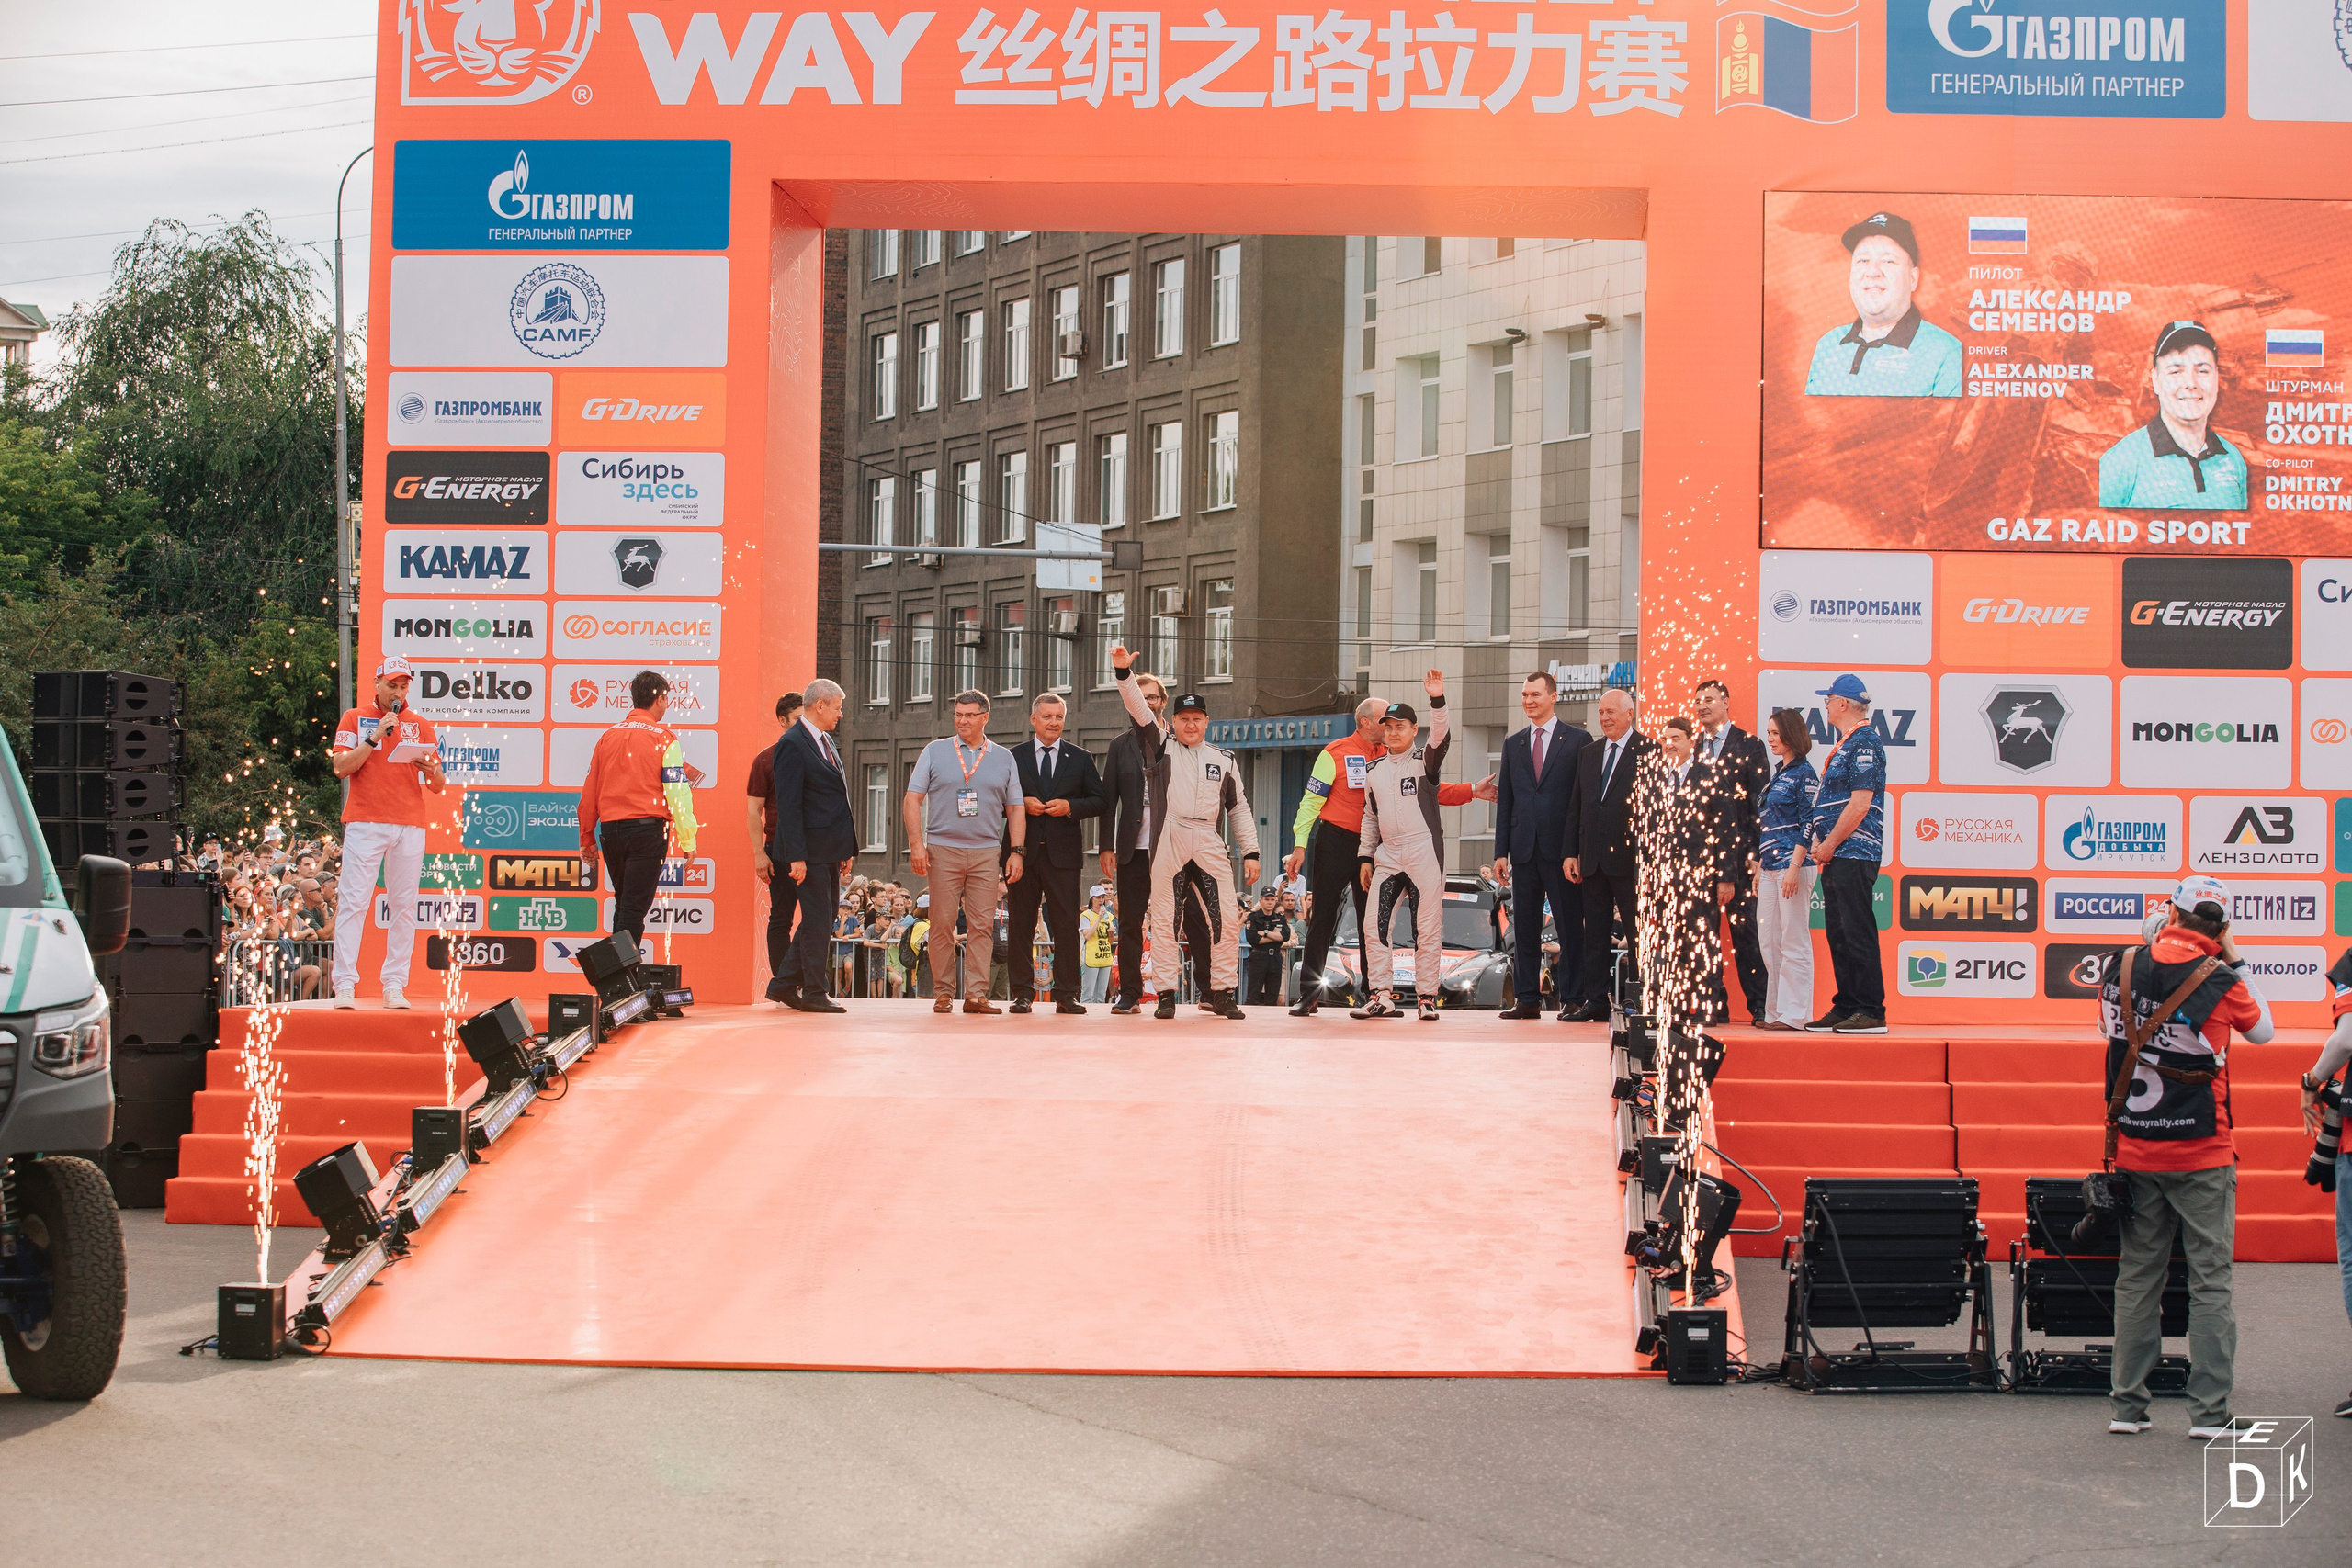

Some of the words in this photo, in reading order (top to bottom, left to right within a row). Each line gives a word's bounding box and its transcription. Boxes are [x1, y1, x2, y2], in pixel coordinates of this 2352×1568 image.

[2006, 16, 2185, 62] ГАЗПРОМ
[628, 12, 937, 105] WAY
[956, 7, 1690, 117] 丝绸之路拉力赛
[1931, 73, 2084, 96] ГЕНЕРАЛЬНЫЙ
[2091, 77, 2184, 97] ПАРТНЕР
[531, 194, 634, 220] ГАЗПРОМ
[488, 226, 576, 240] ГЕНЕРАЛЬНЫЙ
[579, 228, 633, 241] ПАРТНЕР
[1968, 267, 2023, 280] ПИЛОТ
[1968, 288, 2132, 314] АЛЕКСАНДР
[1968, 311, 2096, 333] СЕМЕНОВ
[523, 328, 592, 342] CAMF
[1968, 346, 2007, 355] DRIVER
[1967, 363, 2095, 380] ALEXANDER
[1968, 381, 2068, 399] SEMENOV
[2265, 380, 2344, 394] ШТУРМАН
[435, 400, 543, 417] ГАЗПРОМБАНК
[582, 457, 684, 485] Сибирь
[2265, 459, 2314, 468] CO-PILOT
[622, 482, 699, 502] здесь
[2265, 476, 2344, 493] DMITRY
[2265, 494, 2352, 511] OKHOTN
[1986, 517, 2052, 542] GAZ
[2061, 519, 2139, 544] RAID
[2147, 520, 2252, 545] SPORT
[400, 545, 531, 580] KAMAZ
[1810, 599, 1922, 616] ГАЗПРОМБАНК
[394, 618, 534, 639] MONGOLIA
[602, 620, 711, 637] СОГЛАСИЕ
[649, 638, 711, 648] страхование
[420, 671, 533, 700] Delko
[605, 680, 689, 694] РУАЯ
[605, 695, 701, 709] МЕХИКА
[1211, 720, 1332, 742] ИРКУТСКСТАТ
[1772, 706, 1917, 747] AAZ
[2132, 722, 2279, 744] MONGOLIA
[447, 747, 500, 761] ГАЗПРОМ
[1306, 783, 1322, 794] WAY
[1308, 777, 1323, 788] SILK
[528, 802, 578, 813] БАЙКА
[527, 817, 580, 829] ЭКО.ЦЕ
[1944, 818, 2013, 830] РУССКАЯ
[2098, 821, 2165, 840] ГАЗПРОМ
[1944, 831, 2024, 844] МЕХАНИКА
[2099, 842, 2164, 852] ДОБЫЧА
[2097, 853, 2165, 863] ИРКУТСК
[2198, 852, 2319, 864] ЛЕНЗОЛОТО
[496, 859, 591, 887] МАТЧ!
[686, 869, 705, 882] 24
[381, 900, 451, 922] ИСТИЯ
[1908, 886, 2029, 922] МАТЧ!
[2062, 897, 2136, 915] РОССИЯ
[2233, 895, 2285, 921] ЕСТИЯ
[519, 897, 567, 931] НТВ
[650, 908, 703, 924] 2ГИС
[458, 942, 505, 964] 360
[1955, 959, 2027, 980] 2ГИС
[2248, 964, 2318, 975] ИКОЛОР
